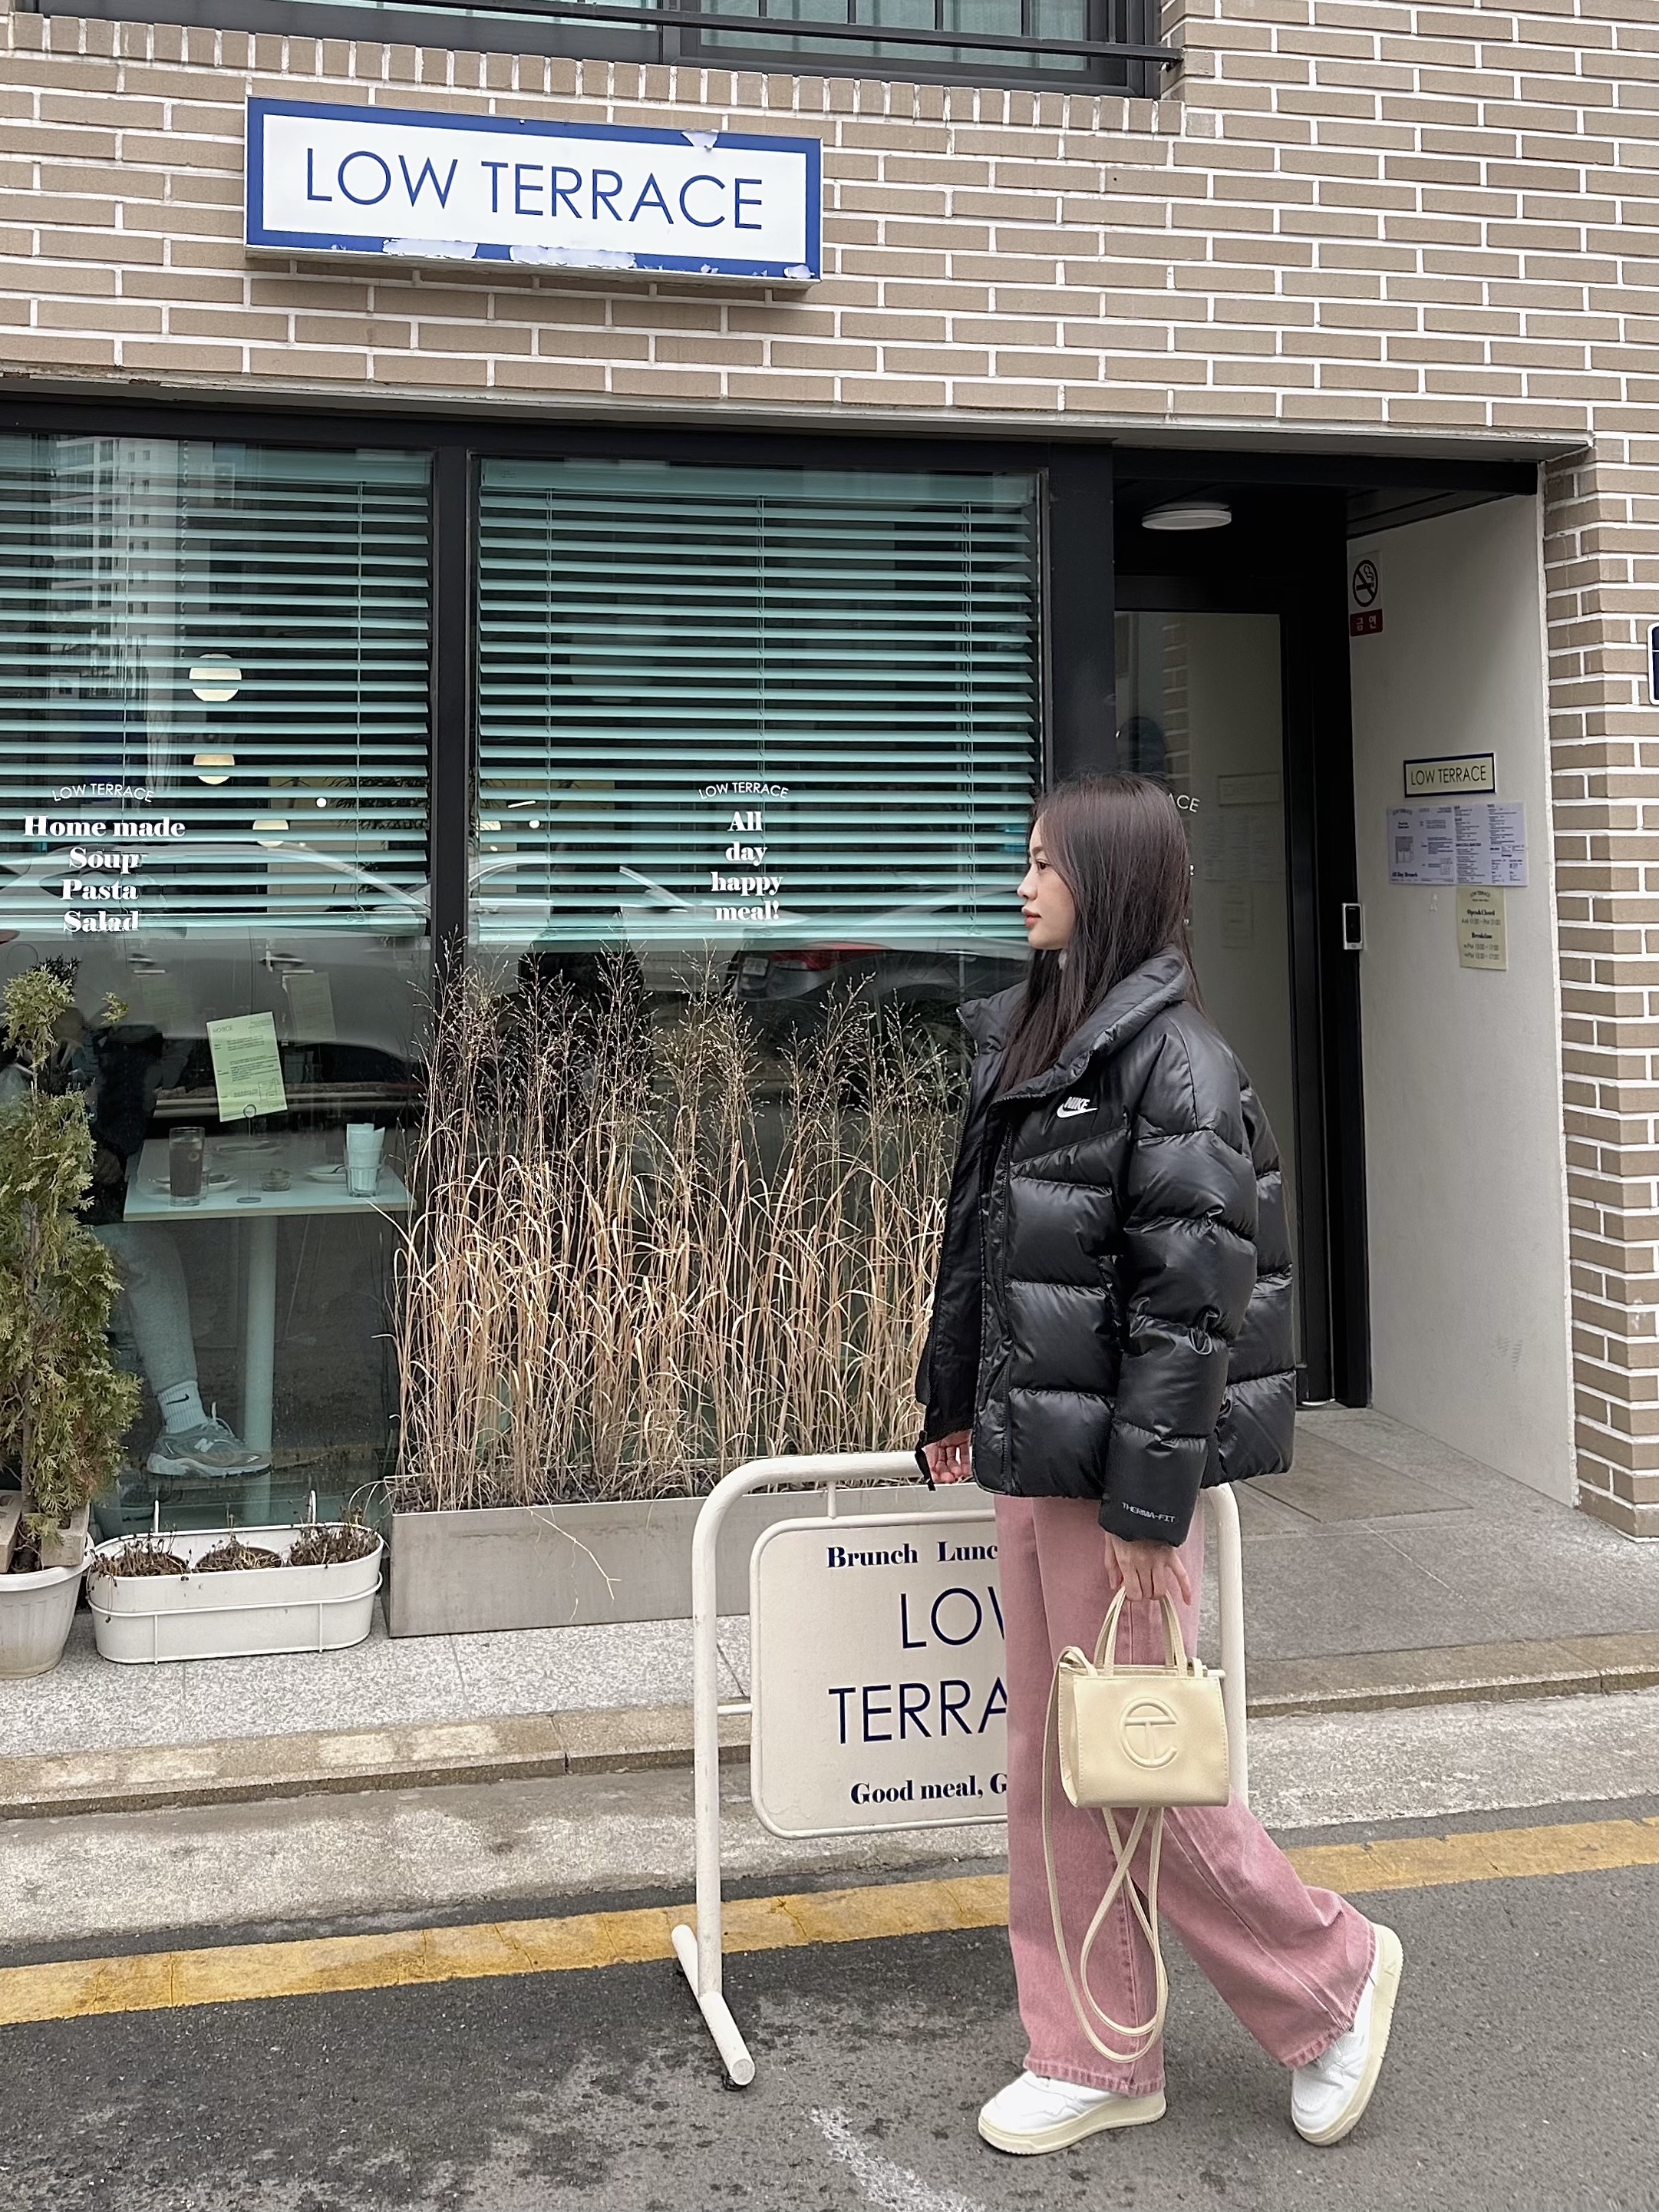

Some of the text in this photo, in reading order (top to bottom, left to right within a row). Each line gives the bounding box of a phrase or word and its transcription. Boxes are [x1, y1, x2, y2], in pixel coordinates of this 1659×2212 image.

[308, 148, 762, 229] LOW TERRACE
[1411, 765, 1486, 786] LOW TERRACE
[52, 784, 154, 802] LOW TERRACE
[698, 782, 788, 799] LOW TERRACE
[22, 815, 186, 837] Home made
[727, 811, 763, 831] All
[69, 847, 141, 874] Soup
[725, 841, 767, 866] day
[60, 879, 139, 900] Pasta
[711, 871, 783, 896] happy
[715, 900, 779, 921] meal!
[64, 911, 139, 933] Salad
[1064, 1096, 1090, 1111] NIKE
[1122, 1501, 1176, 1523] THERMA-FIT
[826, 1541, 998, 1568] Brunch Lunc
[828, 1676, 1008, 1745] TERRA
[850, 1780, 914, 1805] Good
[920, 1775, 983, 1798] meal,
